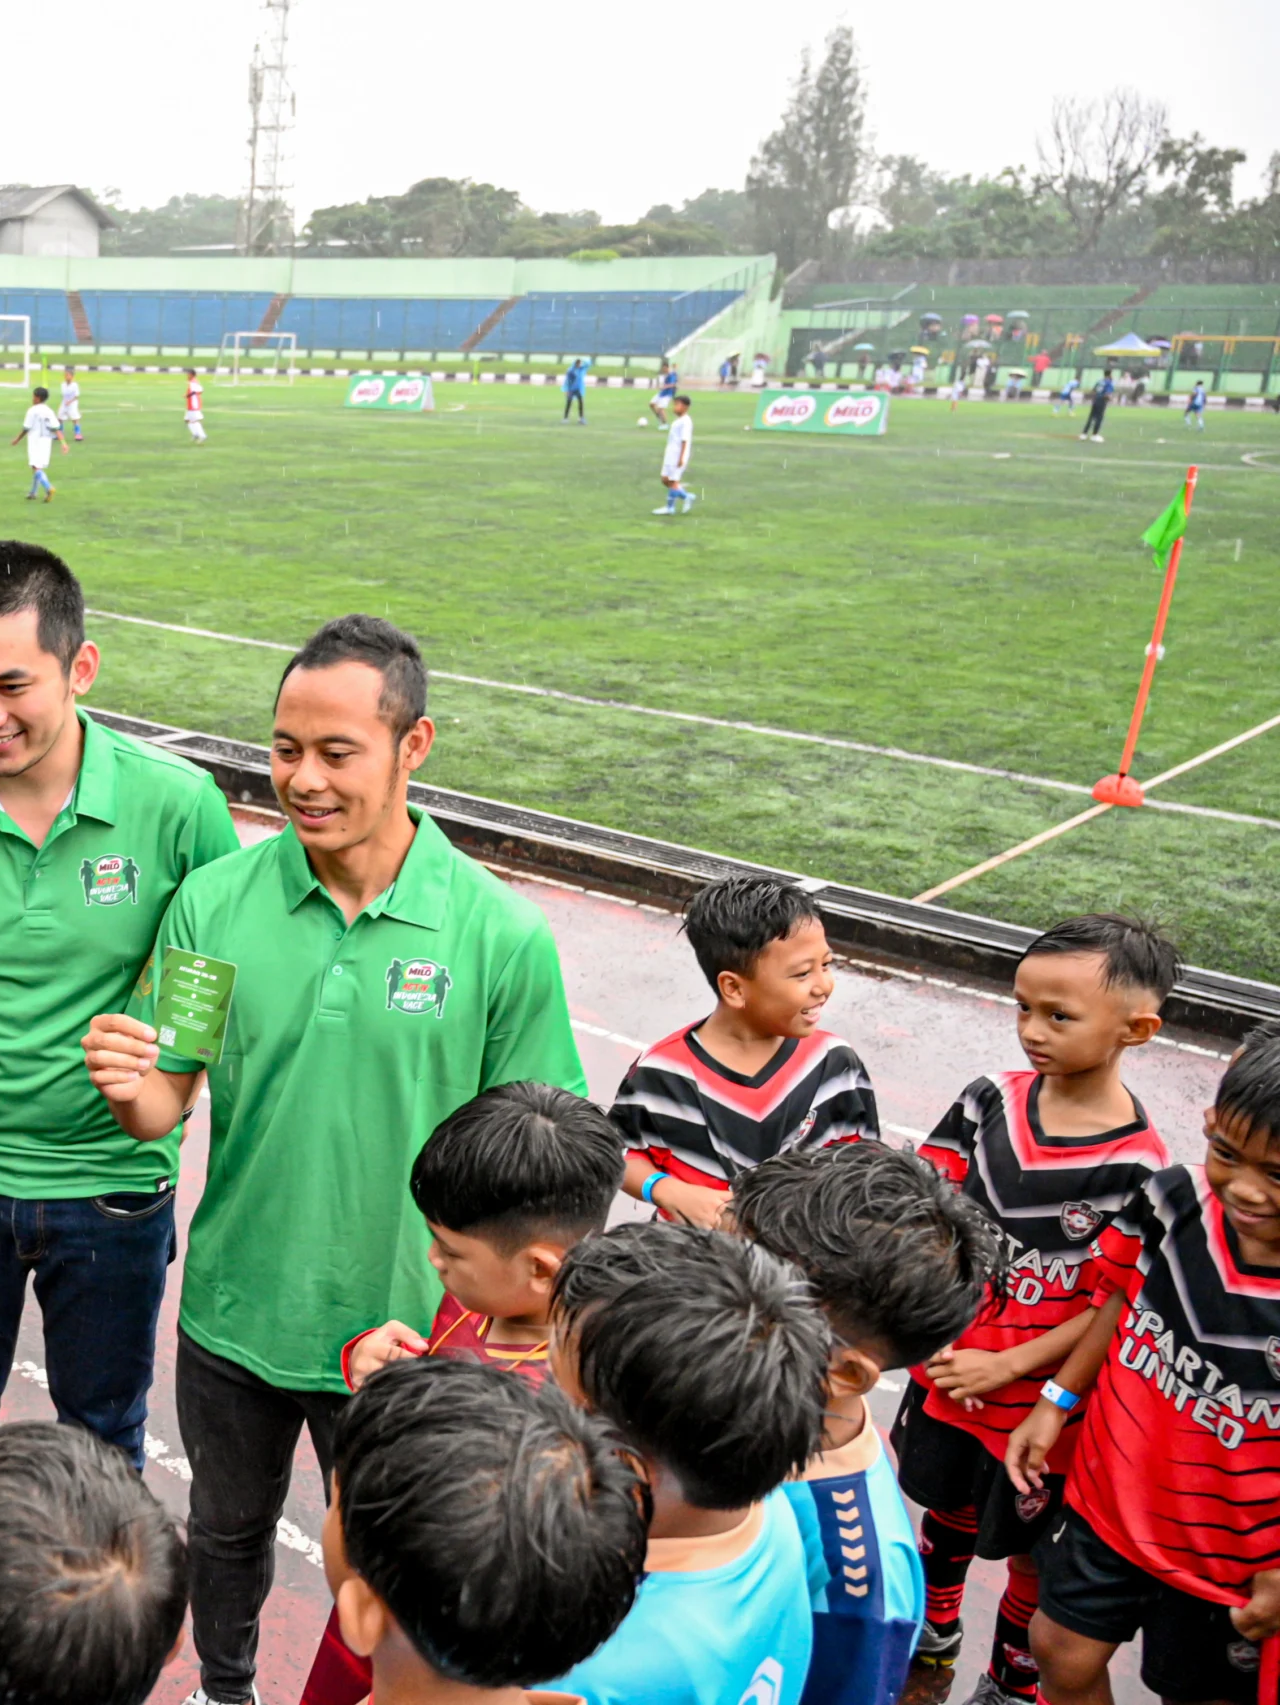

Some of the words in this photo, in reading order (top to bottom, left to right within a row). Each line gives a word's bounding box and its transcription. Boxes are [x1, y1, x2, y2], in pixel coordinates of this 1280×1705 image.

[770, 404, 809, 418] MILO
[832, 405, 873, 418] MILO
[98, 862, 120, 872] MILO
[408, 967, 432, 977] MILO
[1118, 1336, 1245, 1450] UNITED
